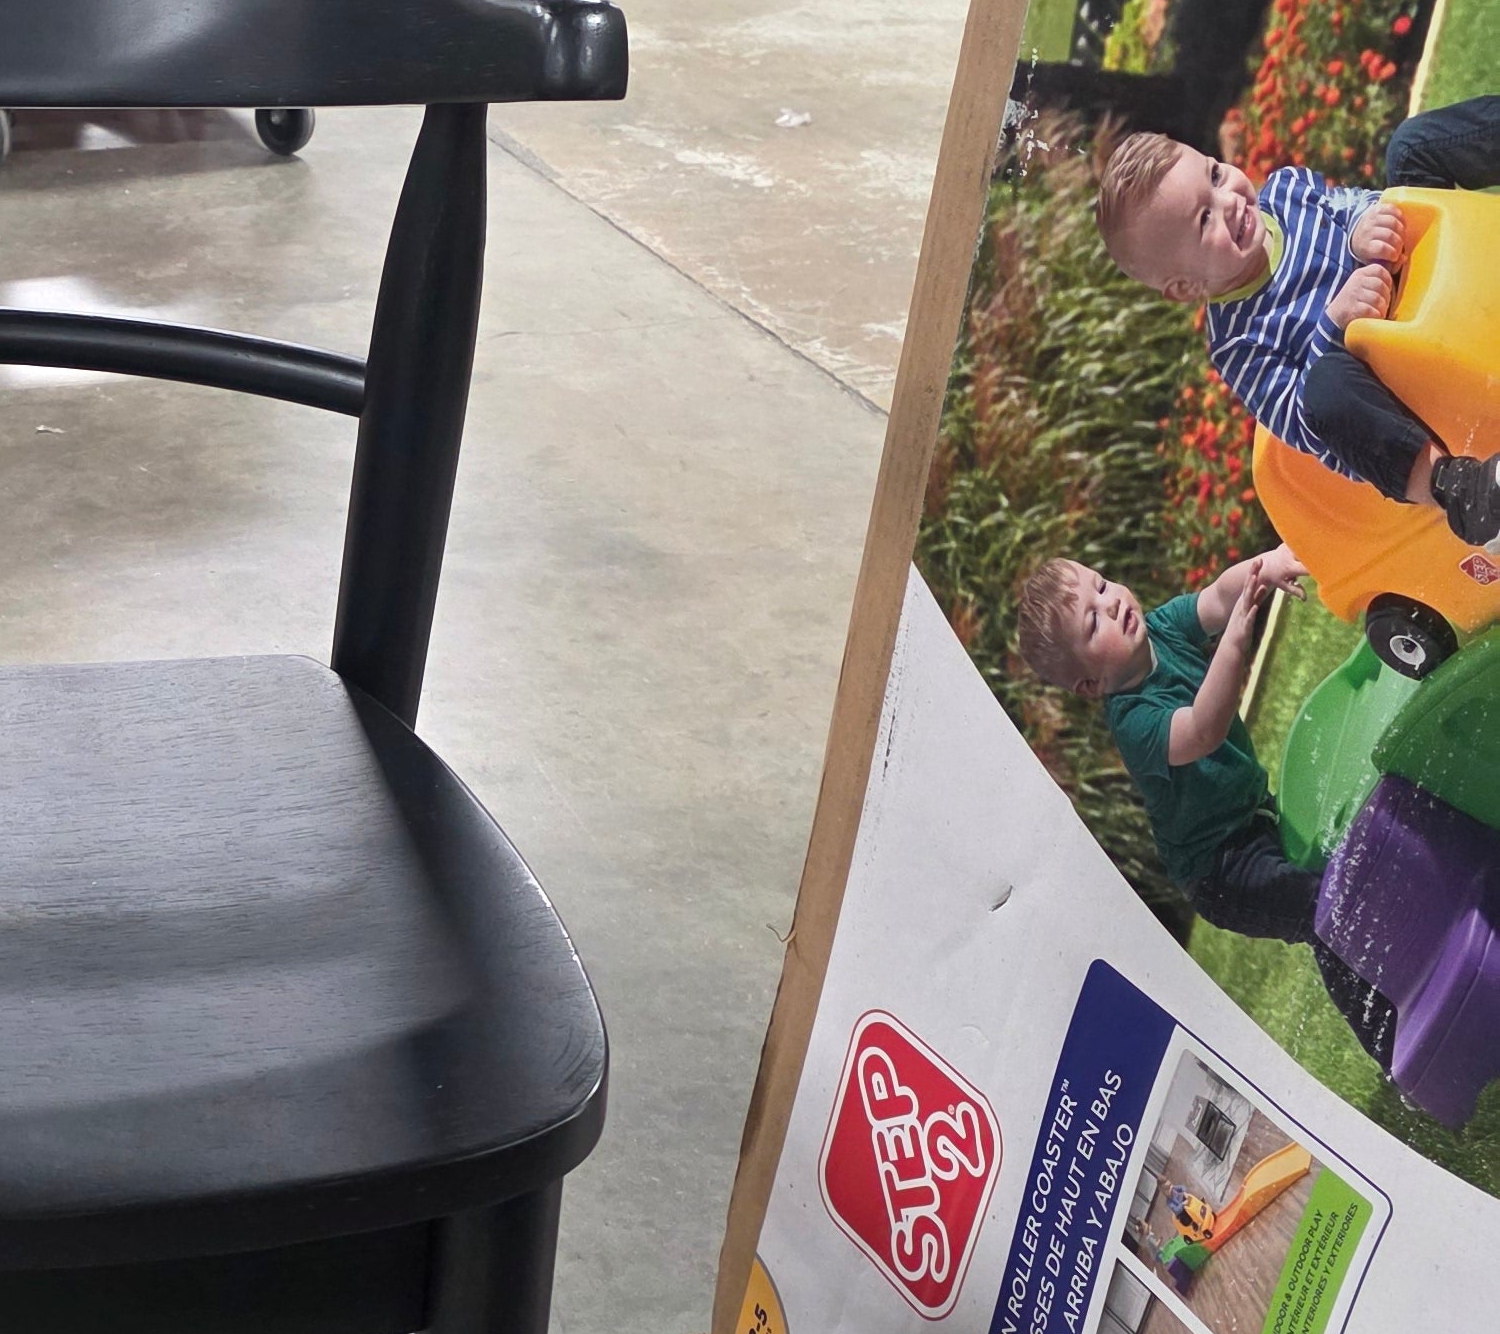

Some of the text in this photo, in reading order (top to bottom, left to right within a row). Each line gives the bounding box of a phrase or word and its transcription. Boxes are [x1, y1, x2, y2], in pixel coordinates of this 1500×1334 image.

[1090, 1069, 1122, 1121] BAS
[858, 1046, 951, 1284] STEP
[1076, 1119, 1101, 1161] EN
[1094, 1123, 1134, 1212] ABAJO
[1055, 1157, 1085, 1236] HAUT
[1086, 1207, 1103, 1229] Y
[1307, 1209, 1324, 1238] PLAY
[1045, 1235, 1066, 1277] DE
[1306, 1268, 1315, 1285] ET
[1311, 1211, 1339, 1271] EXTÉRIEUR
[1328, 1202, 1358, 1266] EXTERIORES
[1007, 1215, 1042, 1317] ROLLER
[1063, 1237, 1098, 1334] ARRIBA
[1287, 1238, 1313, 1292] OUTDOOR
[1285, 1292, 1293, 1302] &
